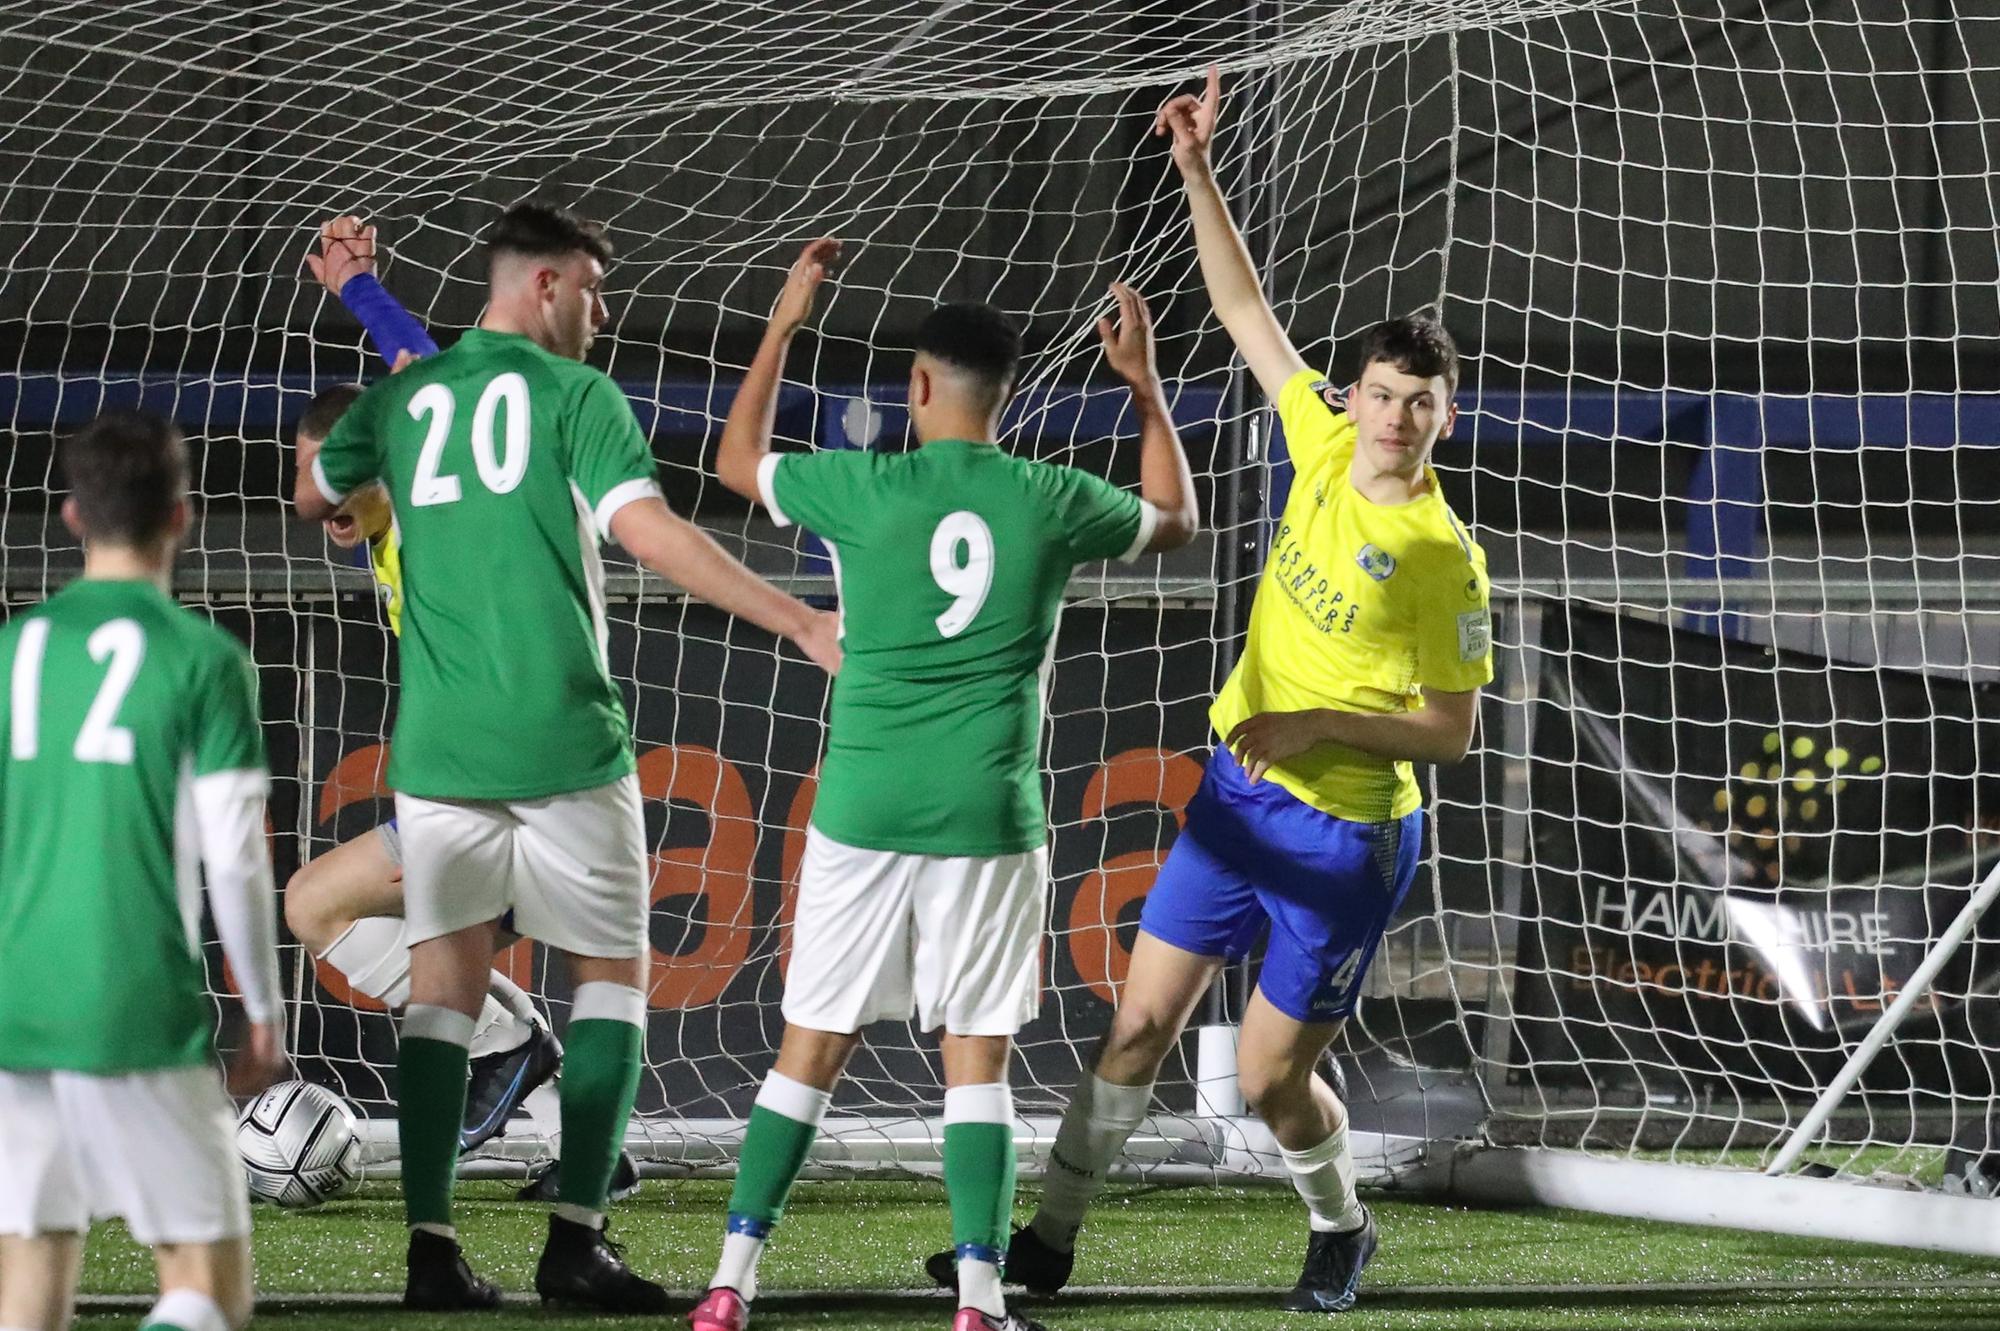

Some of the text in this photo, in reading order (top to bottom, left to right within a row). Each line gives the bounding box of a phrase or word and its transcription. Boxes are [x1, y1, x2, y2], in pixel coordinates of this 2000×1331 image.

[407, 372, 531, 507] 20
[930, 510, 995, 639] 9
[1274, 543, 1353, 632] RINTERS
[11, 616, 147, 765] 12
[1594, 886, 1895, 955] HAMHIRE
[1331, 948, 1361, 996] 4
[1572, 946, 1828, 1014] Electricl
